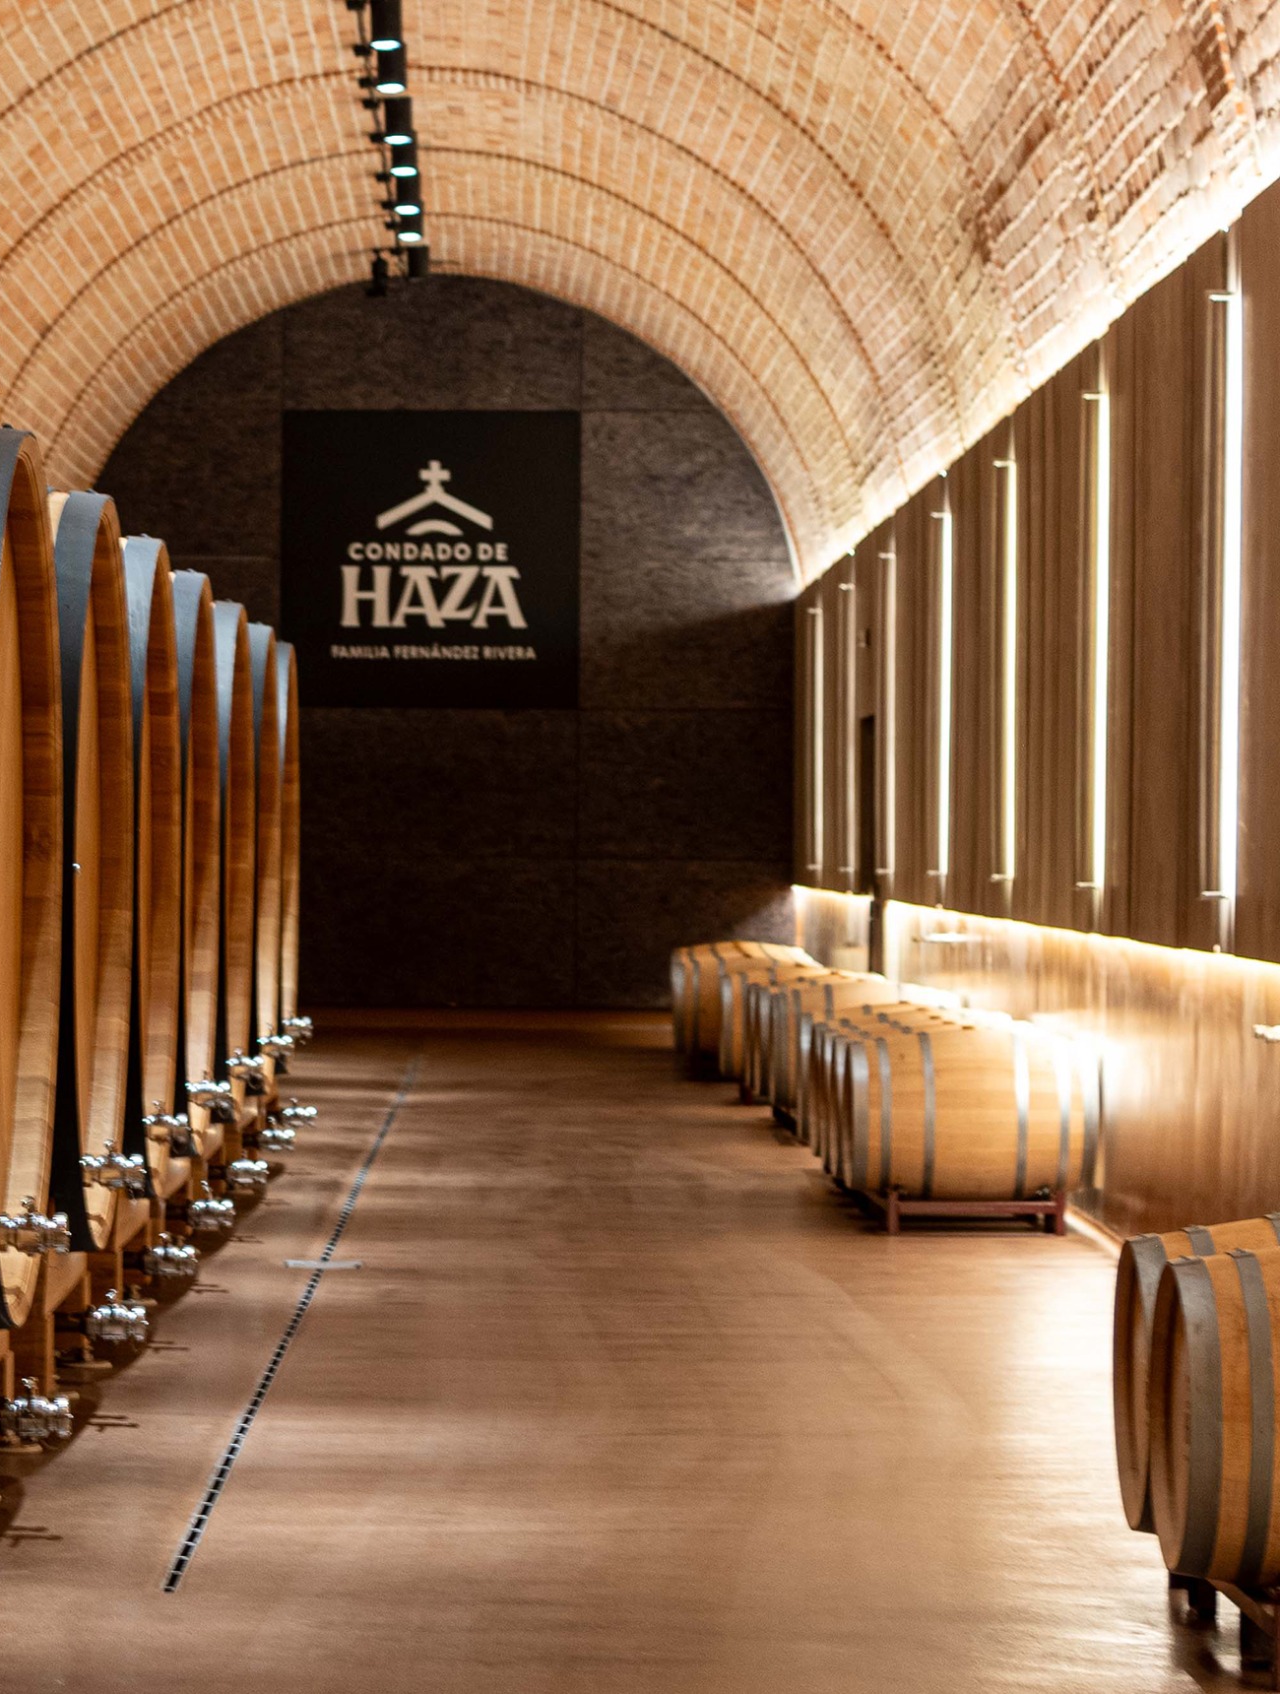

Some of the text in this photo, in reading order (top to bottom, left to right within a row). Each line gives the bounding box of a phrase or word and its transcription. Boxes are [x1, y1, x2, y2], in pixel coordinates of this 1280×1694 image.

[348, 542, 508, 561] CONDADO DE
[340, 565, 528, 628] HAZA
[331, 643, 537, 660] FAMILIA FERNÁNDEZ RIVERA
